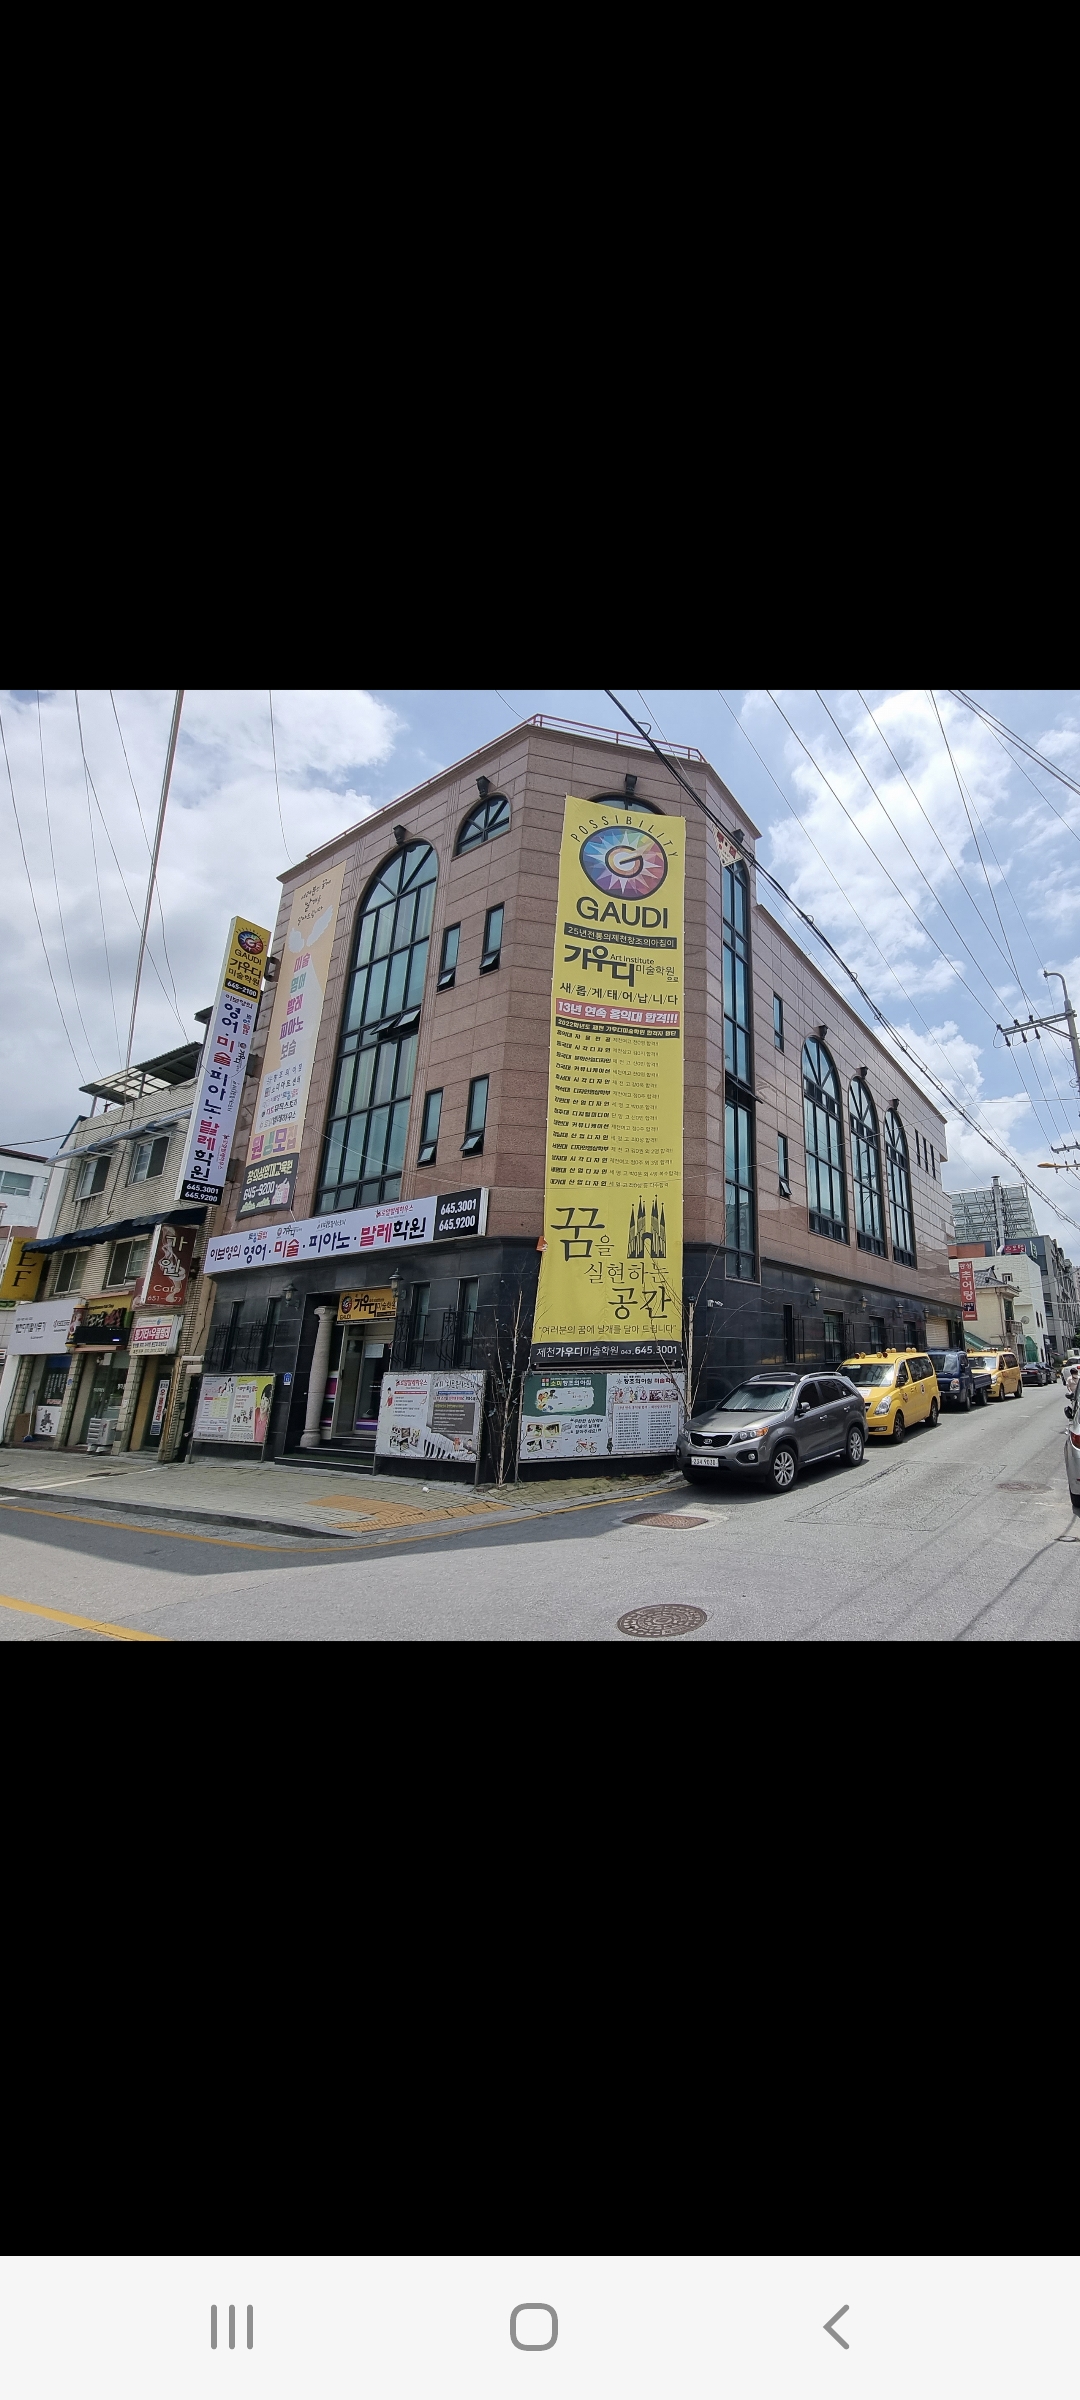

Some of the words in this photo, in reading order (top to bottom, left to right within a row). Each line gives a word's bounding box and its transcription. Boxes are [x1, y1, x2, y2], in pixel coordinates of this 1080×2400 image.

[571, 815, 678, 857] POSSIBILITY
[576, 896, 668, 929] GAUDI
[234, 949, 262, 965] GAUDI
[293, 952, 311, 973] 미술
[564, 945, 634, 987] 가우디
[635, 965, 675, 976] 미술학원
[610, 953, 622, 961] Art
[623, 955, 655, 965] Institute
[229, 968, 260, 986] 미술학원
[230, 958, 262, 979] 가우디
[227, 982, 257, 997] 645-2100
[290, 972, 306, 994] 영어
[286, 993, 304, 1016] 발레
[558, 1001, 582, 1014] 13년
[584, 1005, 607, 1018] 연속
[609, 1008, 643, 1023] 홍익대
[279, 1016, 304, 1040] 피아노
[280, 1039, 297, 1060] 보습
[251, 1125, 298, 1160] 원생모집
[184, 1192, 218, 1202] 645.9200
[186, 1183, 219, 1195] 645.3001
[243, 1181, 275, 1200] 645-9200
[441, 1198, 477, 1215] 645.3001
[439, 1215, 475, 1232] 645.9200
[551, 1207, 614, 1261] 꿈을
[210, 1244, 242, 1261] 이보영의
[244, 1243, 267, 1264] 영어
[274, 1239, 300, 1258] 미술
[309, 1231, 350, 1253] 피아노
[584, 1261, 669, 1284] 실현하는
[962, 1270, 973, 1301] 추어탕
[608, 1285, 672, 1320] 공간
[578, 1325, 595, 1335] 꿈에
[597, 1324, 622, 1335] 날개를
[624, 1324, 640, 1334] 달아
